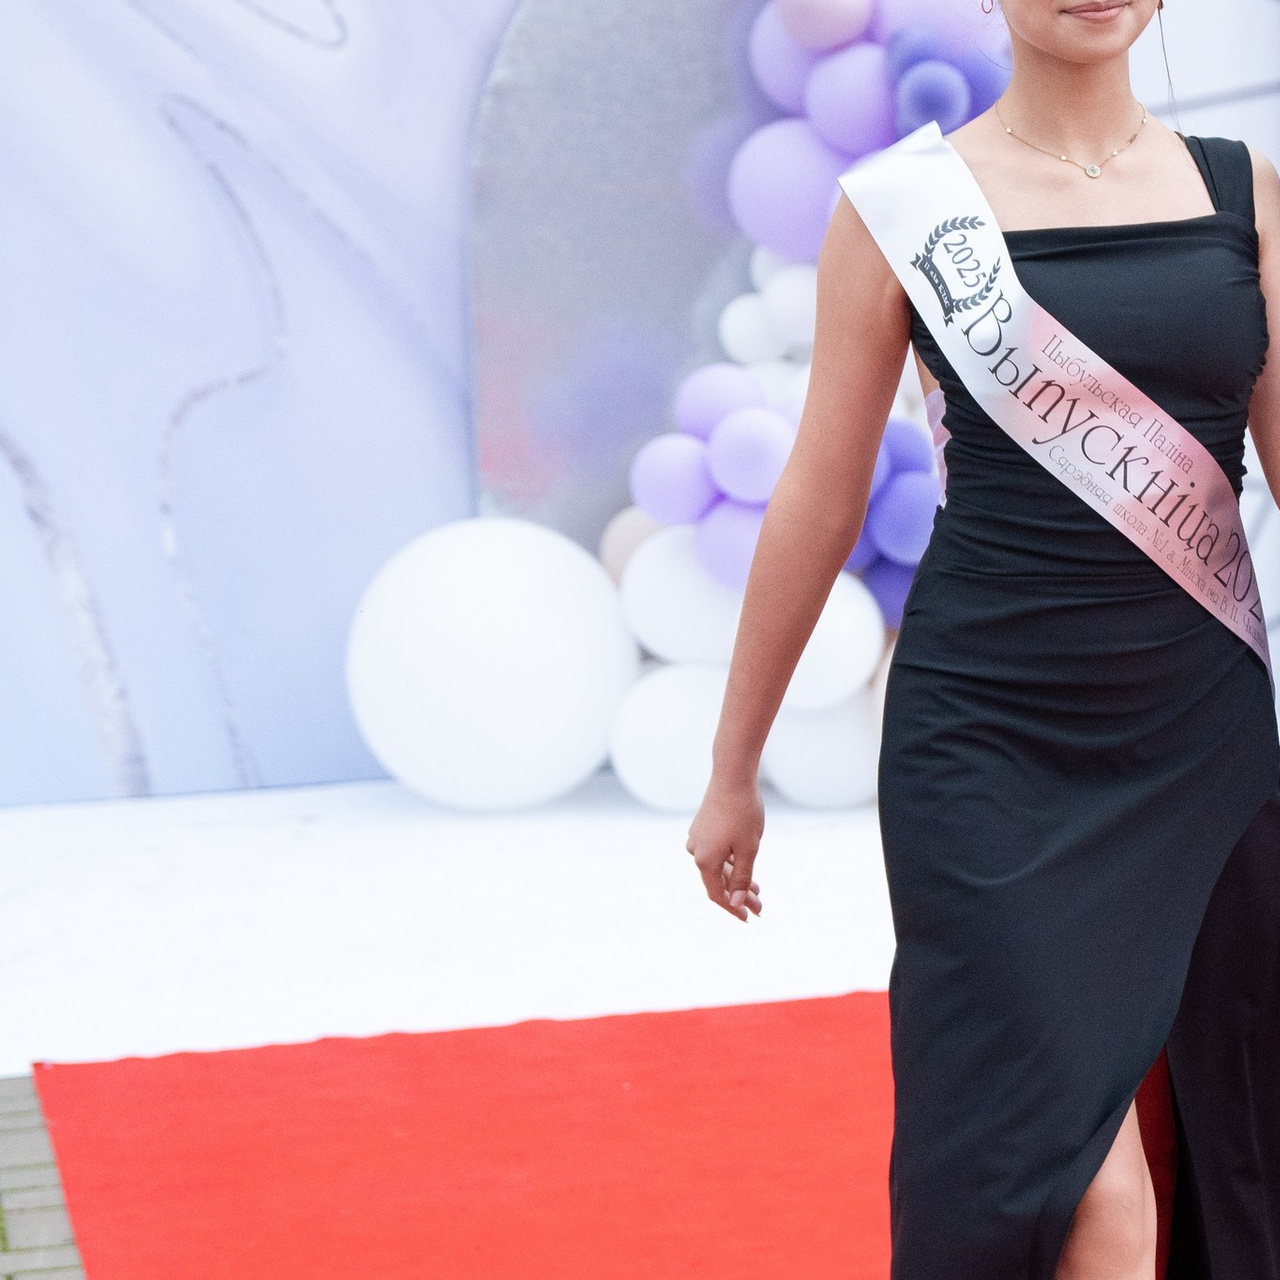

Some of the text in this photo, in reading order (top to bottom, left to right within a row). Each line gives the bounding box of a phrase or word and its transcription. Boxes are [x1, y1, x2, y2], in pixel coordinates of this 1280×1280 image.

[943, 233, 987, 288] 2025
[961, 289, 1219, 566] Выпускніца
[1041, 334, 1194, 475] Цыбульская Паліна
[1048, 445, 1113, 506] Сярэдняя
[1112, 502, 1148, 536] школа
